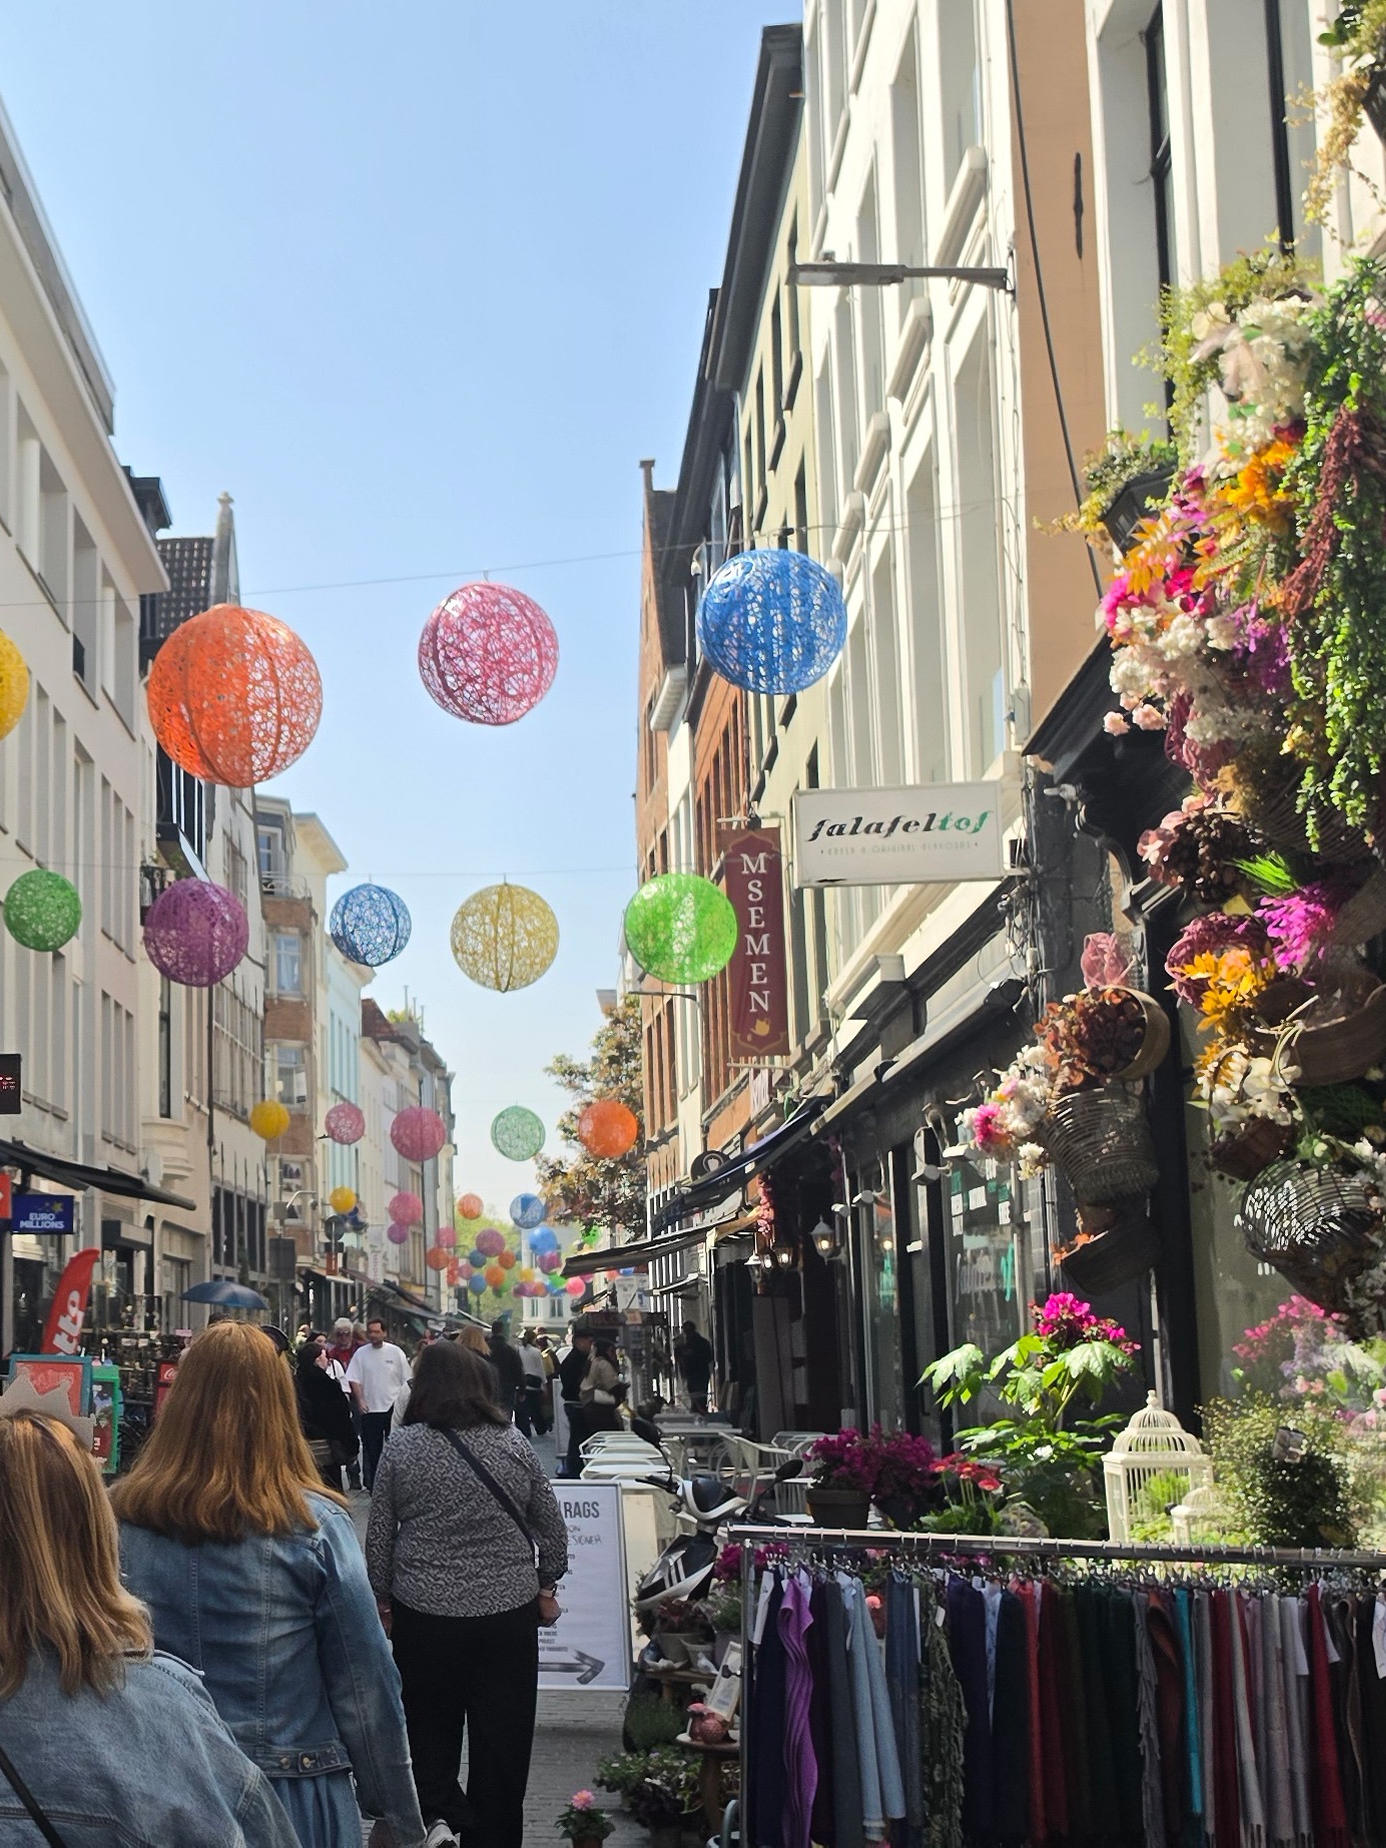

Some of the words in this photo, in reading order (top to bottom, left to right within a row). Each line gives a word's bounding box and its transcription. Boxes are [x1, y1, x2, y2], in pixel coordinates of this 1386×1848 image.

[806, 810, 994, 842] falafeltof
[740, 852, 771, 1013] MSEMEN
[19, 1220, 65, 1229] MILLIONS
[29, 1212, 56, 1221] EURO
